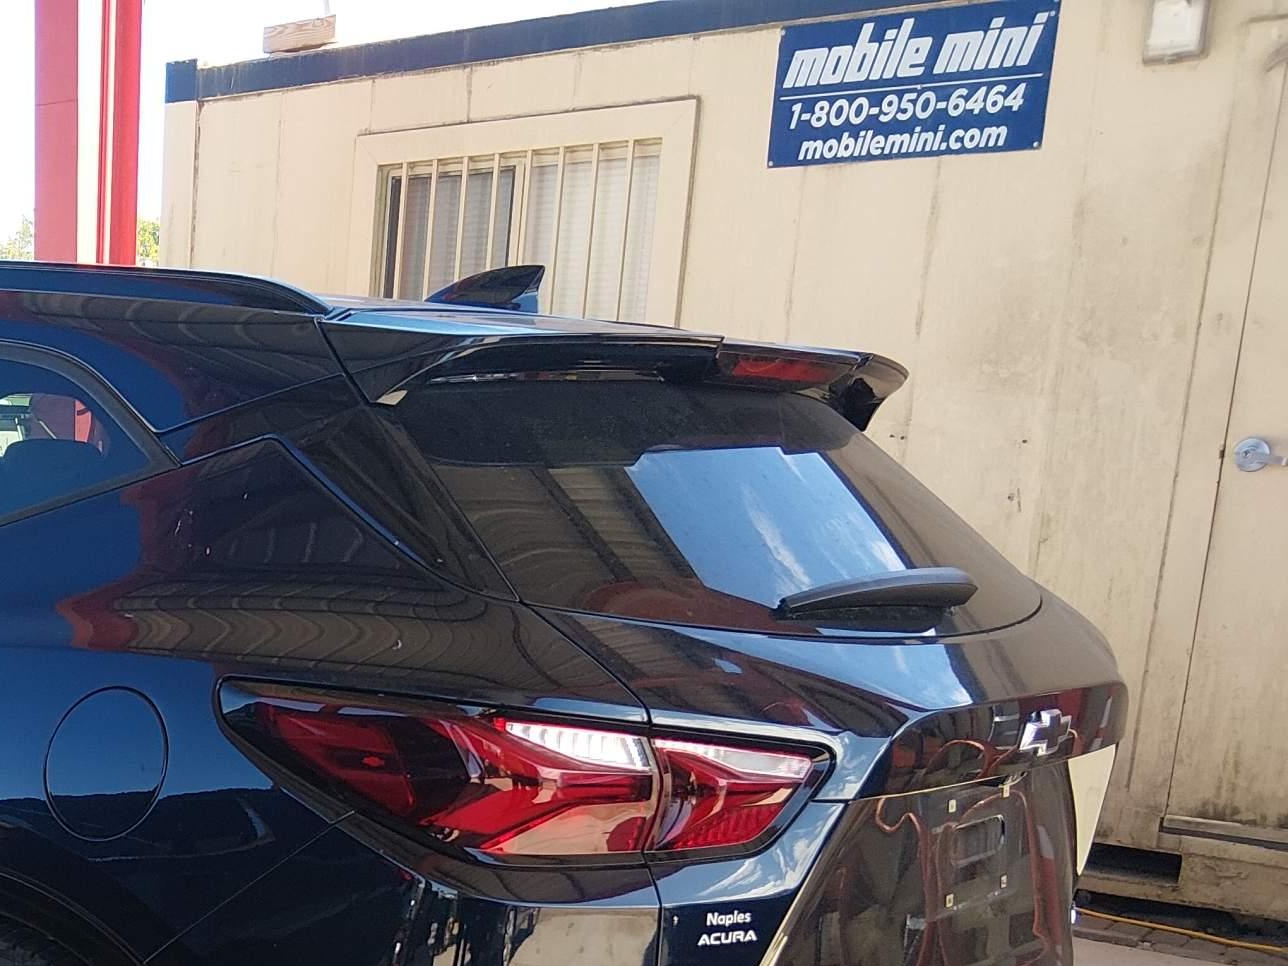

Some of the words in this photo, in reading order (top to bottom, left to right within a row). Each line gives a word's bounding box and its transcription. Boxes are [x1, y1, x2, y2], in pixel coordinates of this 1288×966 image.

[782, 18, 933, 89] mobile
[933, 11, 1050, 75] mini
[789, 82, 1026, 130] 1-800-950-6464
[797, 124, 1008, 161] mobilemini.com
[706, 910, 751, 927] Naples
[697, 930, 757, 946] ACURA
